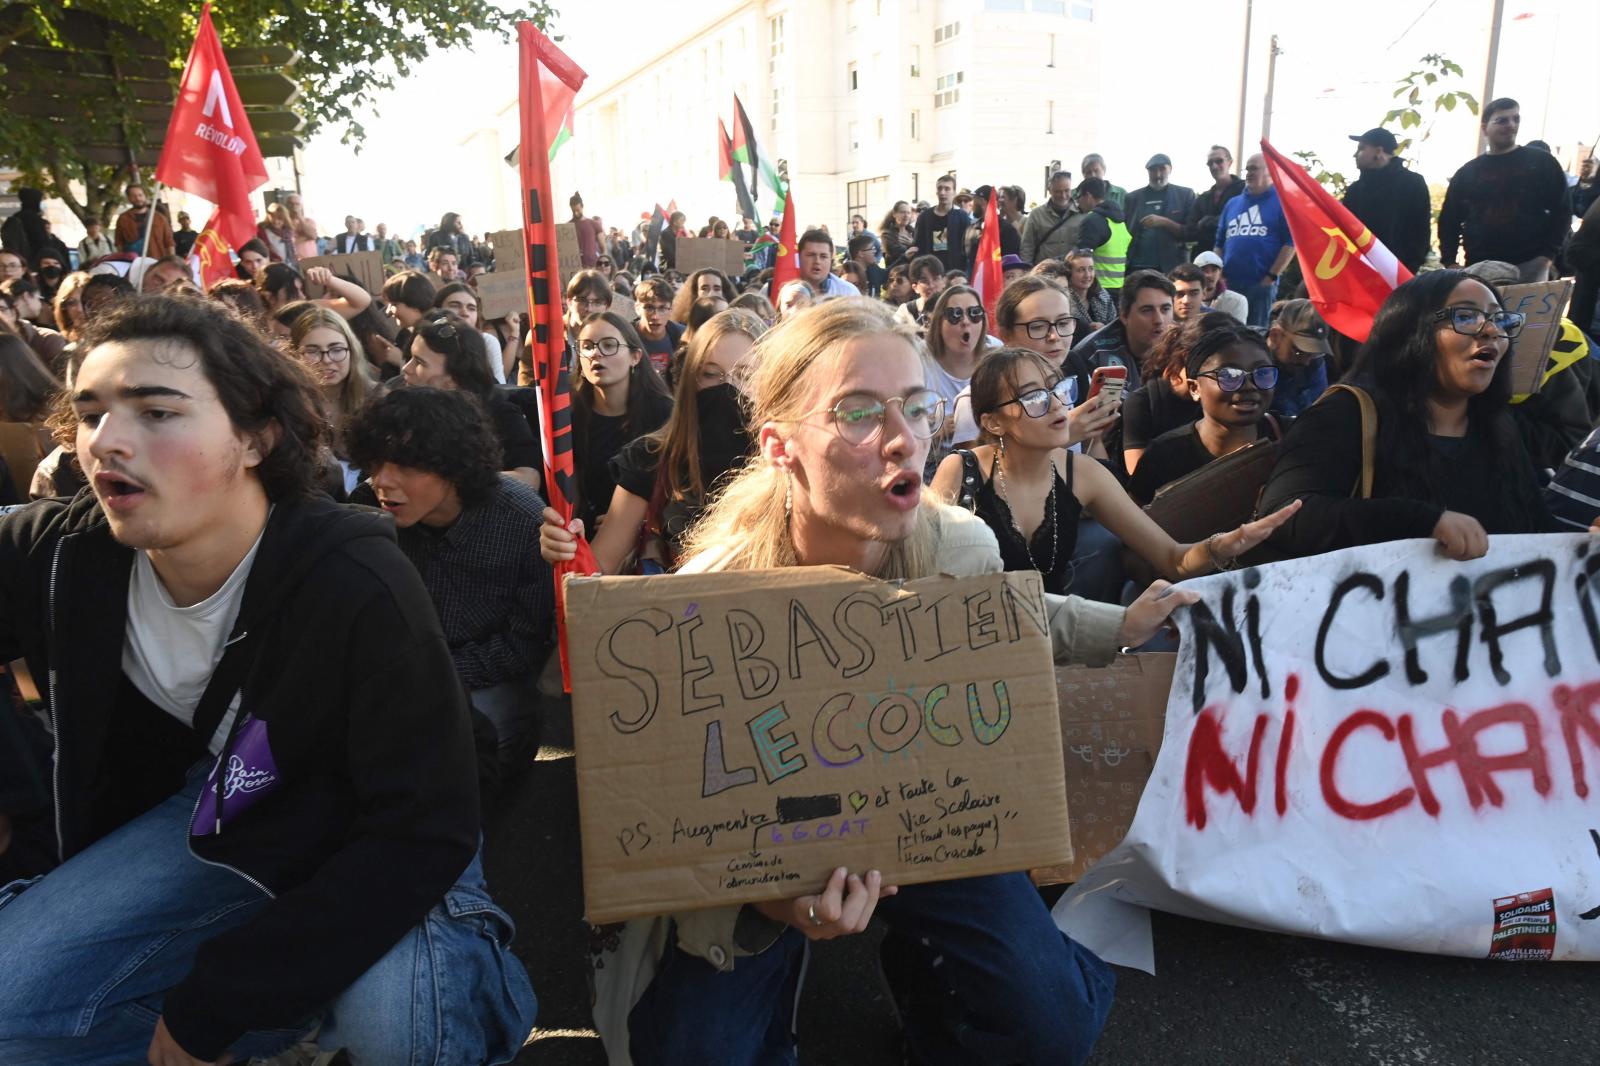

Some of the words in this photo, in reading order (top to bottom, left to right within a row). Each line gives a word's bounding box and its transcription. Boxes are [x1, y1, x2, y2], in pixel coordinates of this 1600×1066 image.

[595, 580, 1050, 734] SÉBASTIEN
[225, 754, 269, 785] Pain
[673, 809, 770, 847] Augmentez
[875, 785, 891, 808] et
[946, 768, 968, 788] la
[899, 808, 931, 833] Vie
[934, 789, 1000, 820] Scolaire
[1500, 900, 1551, 920] SOLIDARITÉ
[1493, 925, 1549, 941] PALESTINIEN
[1490, 948, 1552, 960] TRAVAILLEURS
